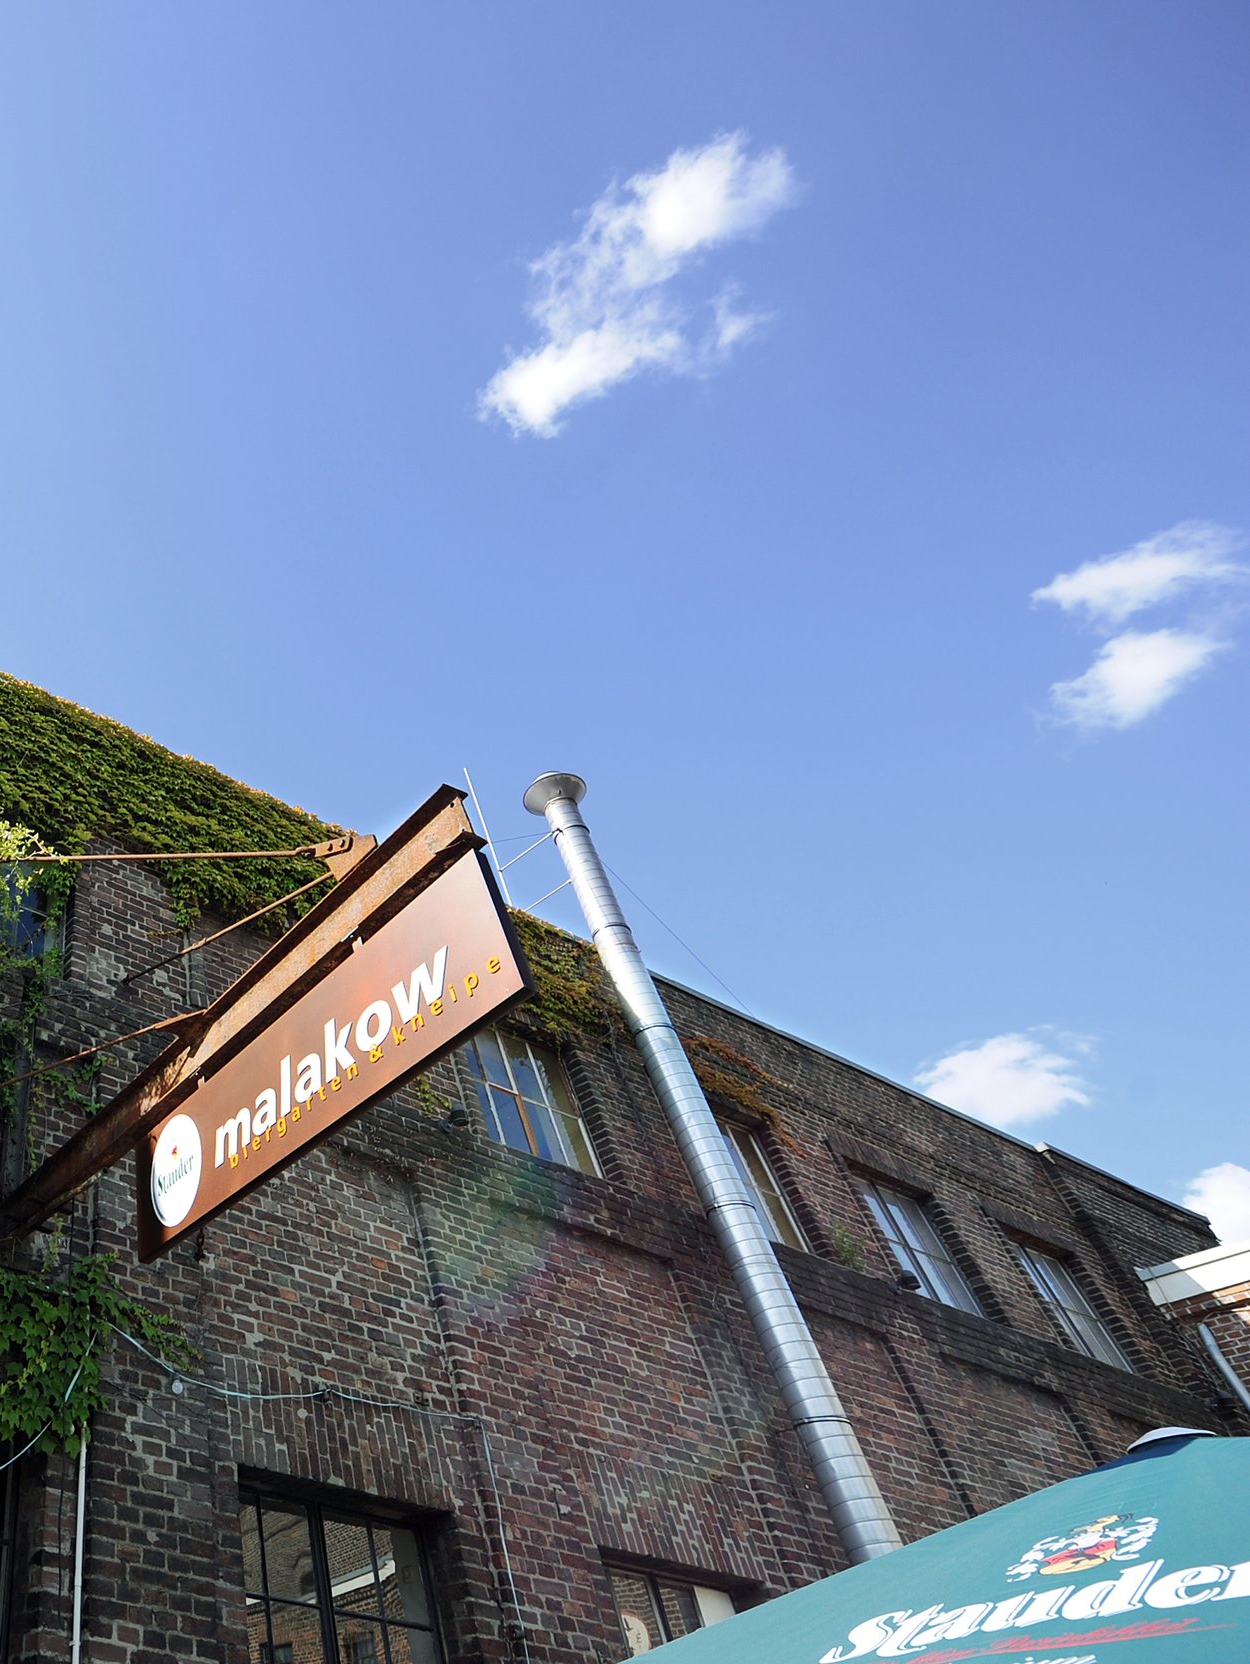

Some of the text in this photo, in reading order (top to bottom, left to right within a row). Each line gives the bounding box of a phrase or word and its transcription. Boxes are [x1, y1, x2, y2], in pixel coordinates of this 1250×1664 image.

[214, 945, 448, 1168] malakow
[368, 1043, 384, 1063] &
[391, 956, 501, 1046] kneipe
